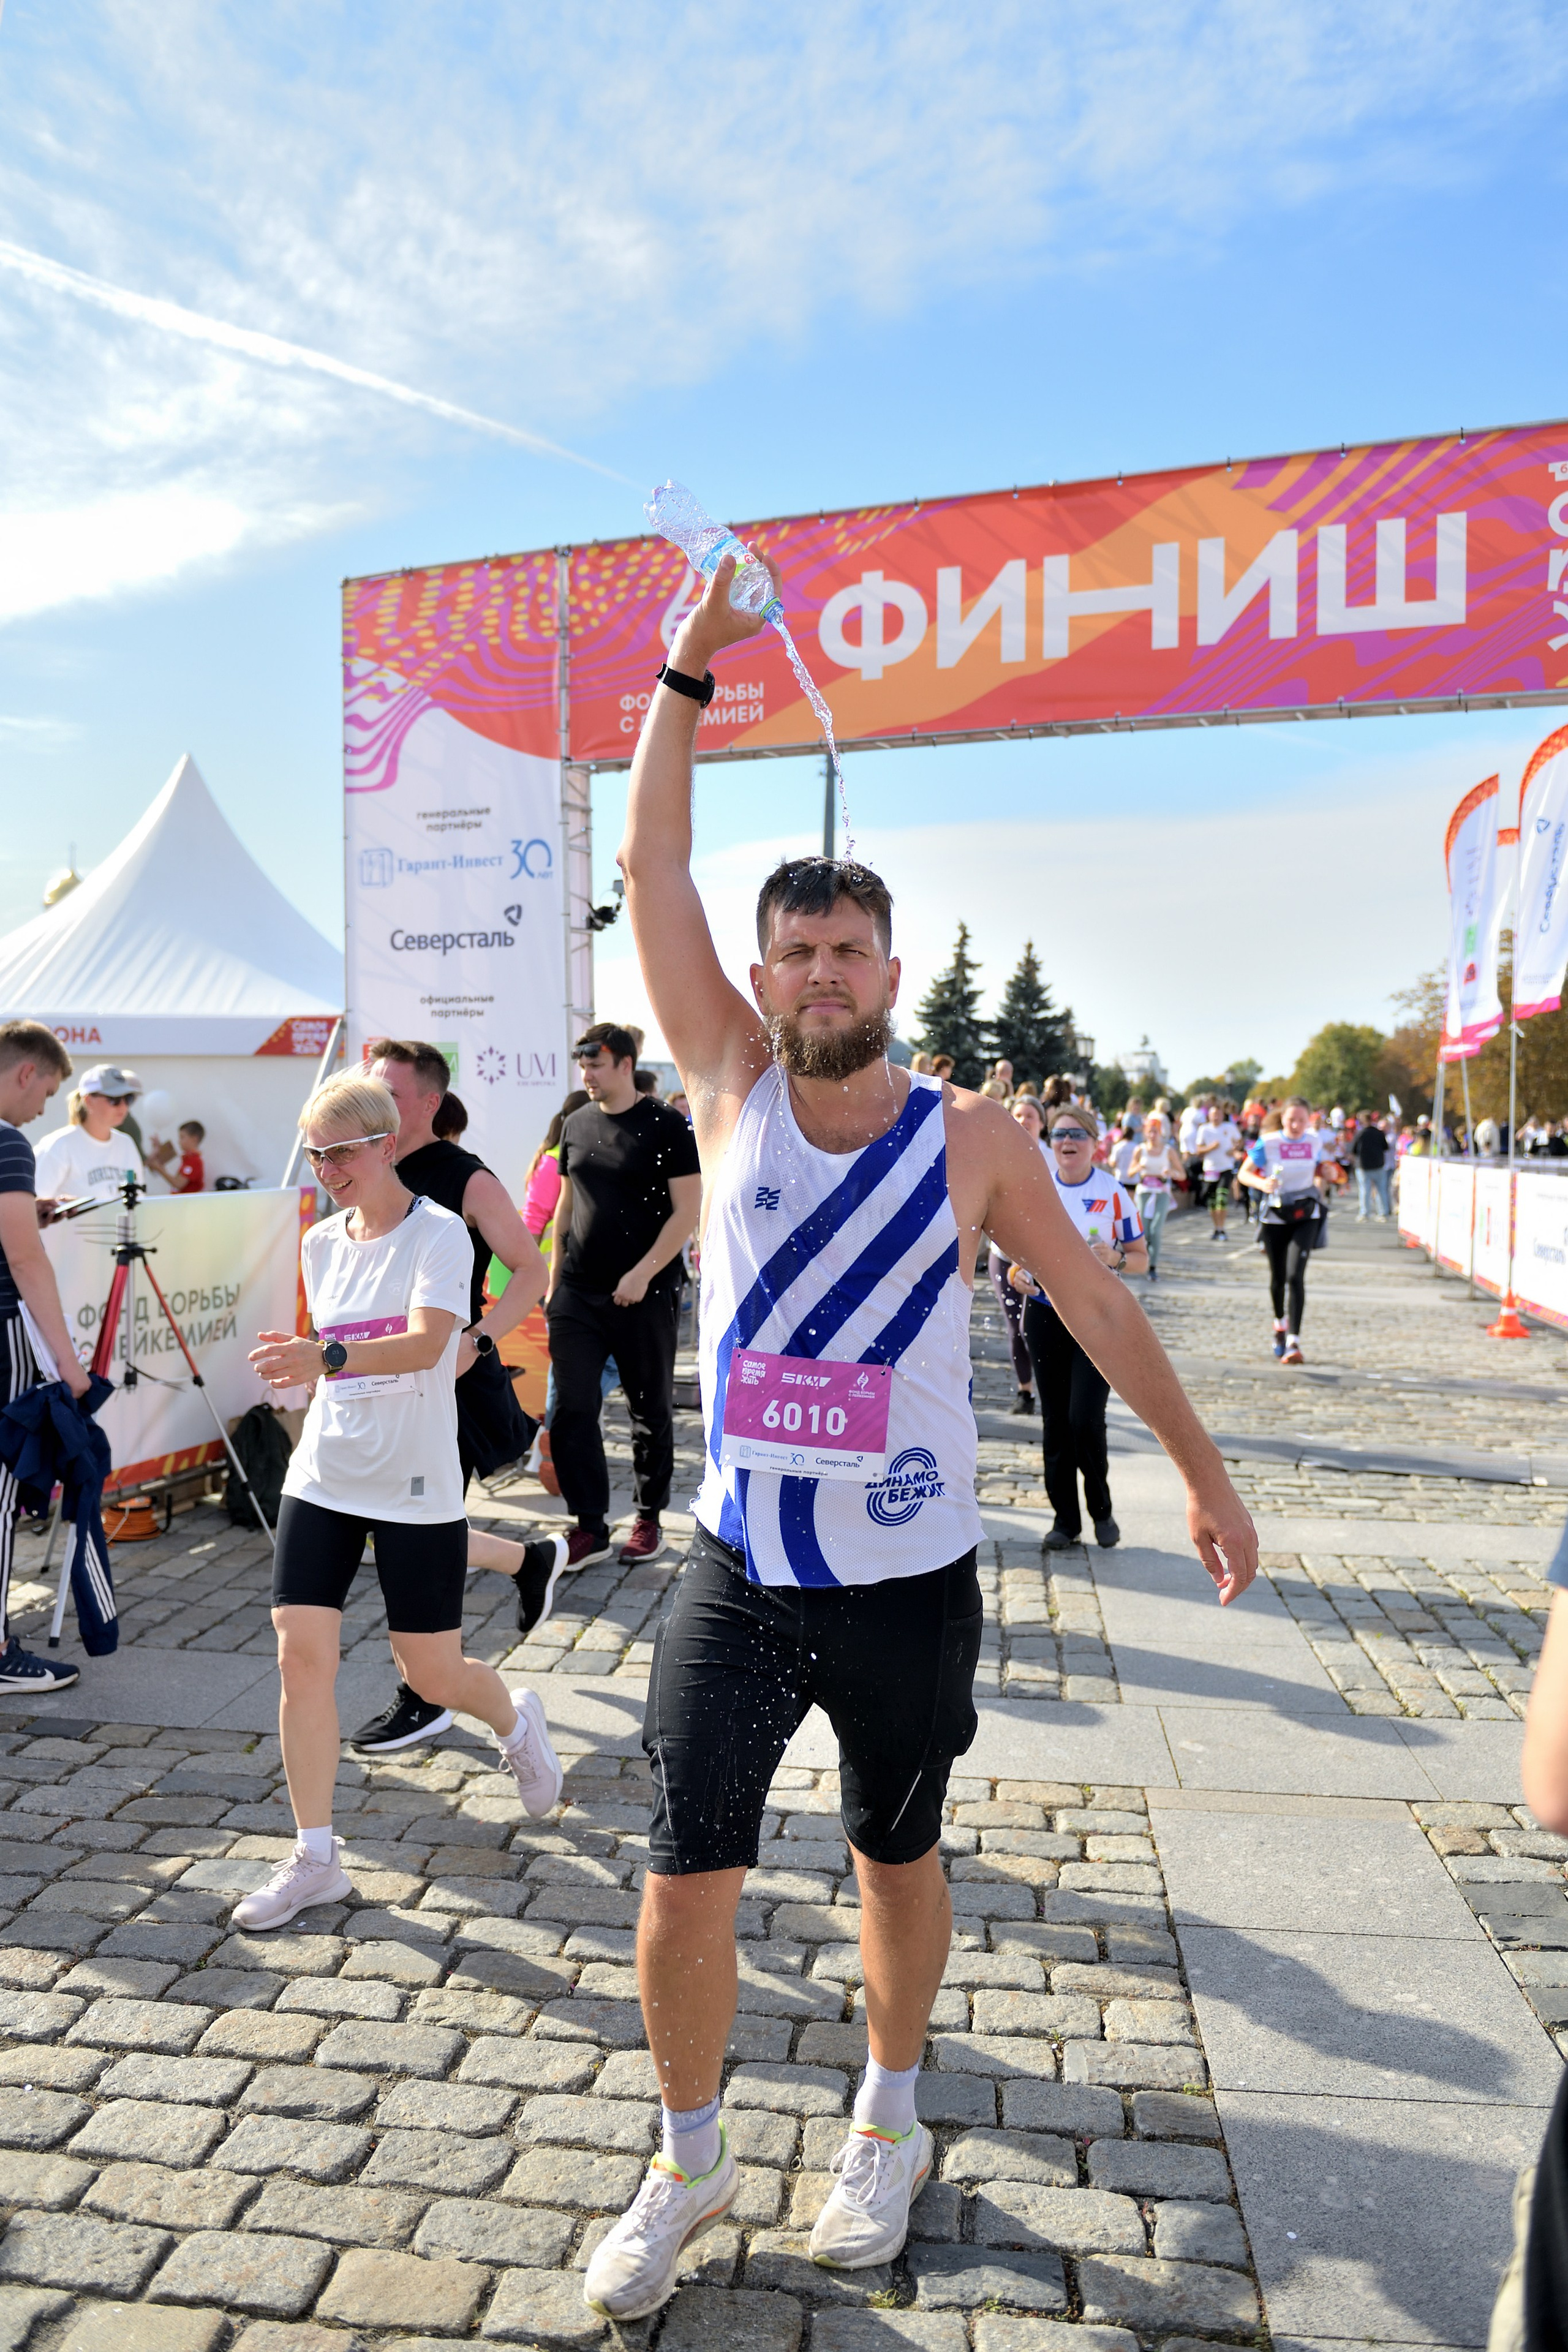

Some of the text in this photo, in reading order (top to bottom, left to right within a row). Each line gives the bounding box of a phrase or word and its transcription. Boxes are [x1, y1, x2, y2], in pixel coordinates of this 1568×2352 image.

[818, 511, 1467, 680] ФИНИШ
[619, 682, 764, 712] ФО РЬБЫ
[417, 807, 491, 820] генеральные
[426, 820, 482, 832] партнёры
[398, 839, 552, 880] Гарант-Инвест 30
[390, 929, 515, 956] Северсталь
[420, 994, 494, 1005] официальные
[431, 1008, 484, 1019] партнёры
[53, 1026, 102, 1044] ОНА
[517, 1053, 556, 1079] UVI
[112, 1311, 237, 1361] ЕЙКЕМИЕЙ
[762, 1400, 846, 1436] 6010
[815, 1457, 860, 1468] Северсталь
[888, 1482, 945, 1503] БЕЖИТ
